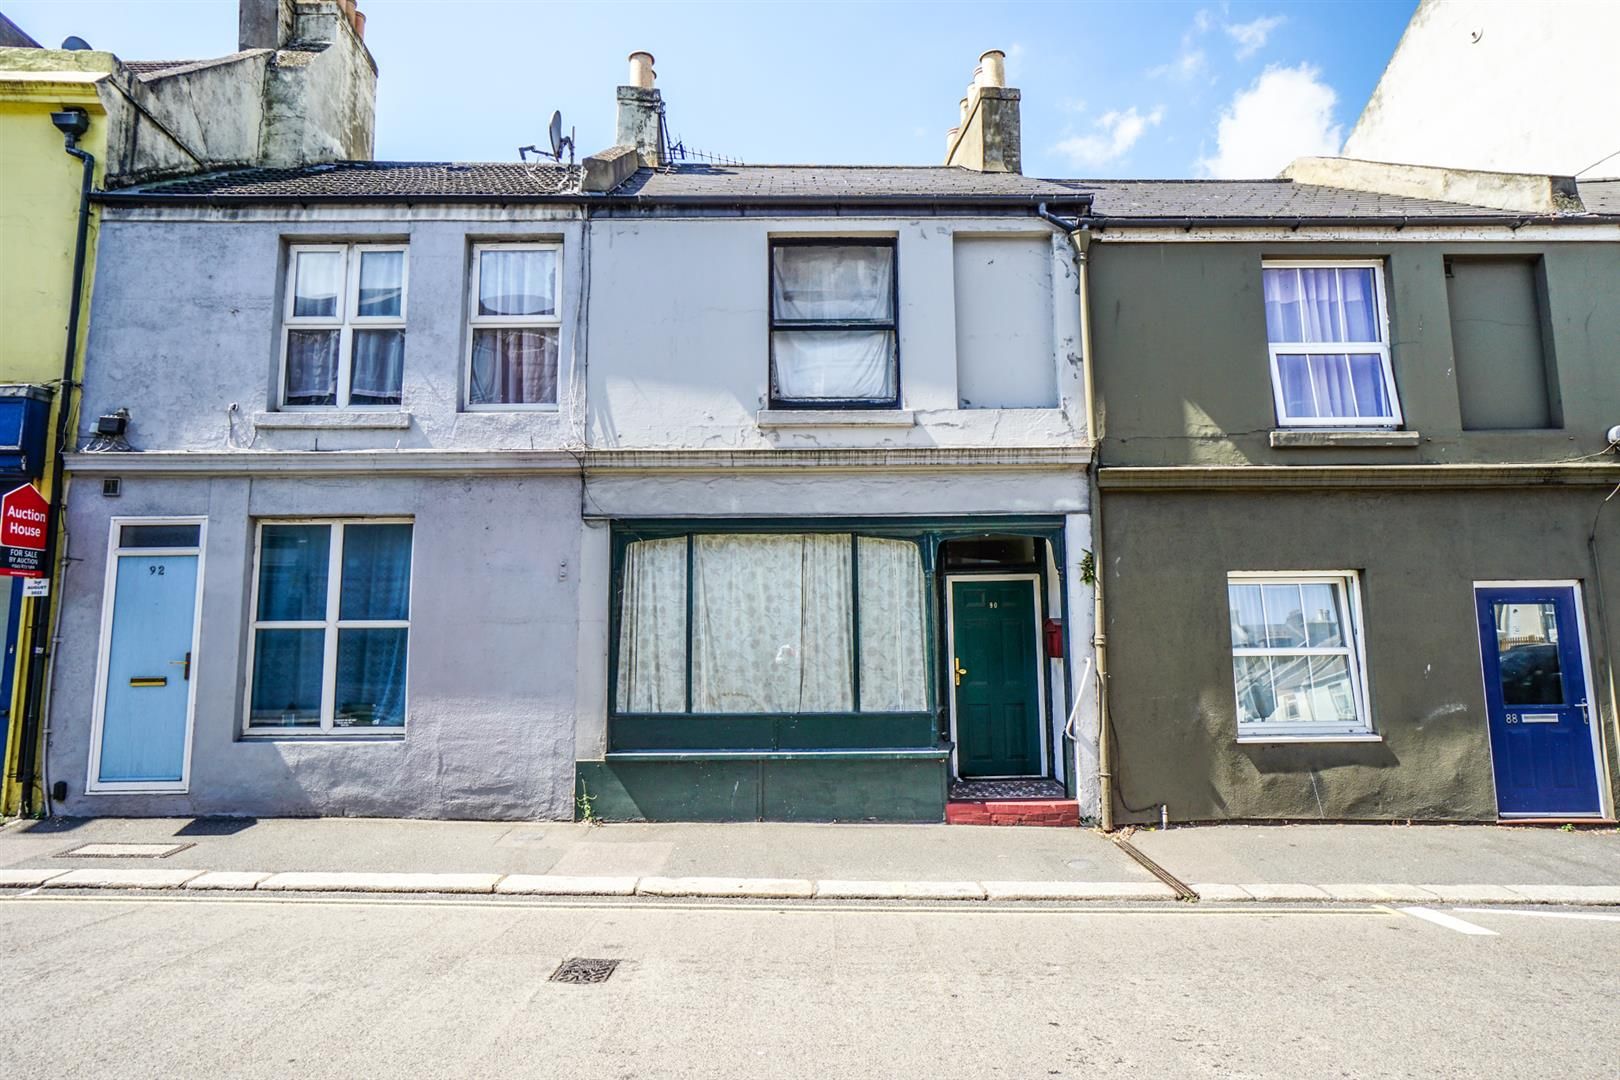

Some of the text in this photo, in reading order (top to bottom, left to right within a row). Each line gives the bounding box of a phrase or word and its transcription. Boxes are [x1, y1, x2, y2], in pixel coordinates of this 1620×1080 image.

[7, 505, 46, 522] Auction
[10, 522, 41, 537] House
[10, 549, 38, 558] FOR SALE
[17, 557, 39, 565] AUCTION
[149, 565, 165, 575] 92
[1505, 713, 1518, 724] 88
